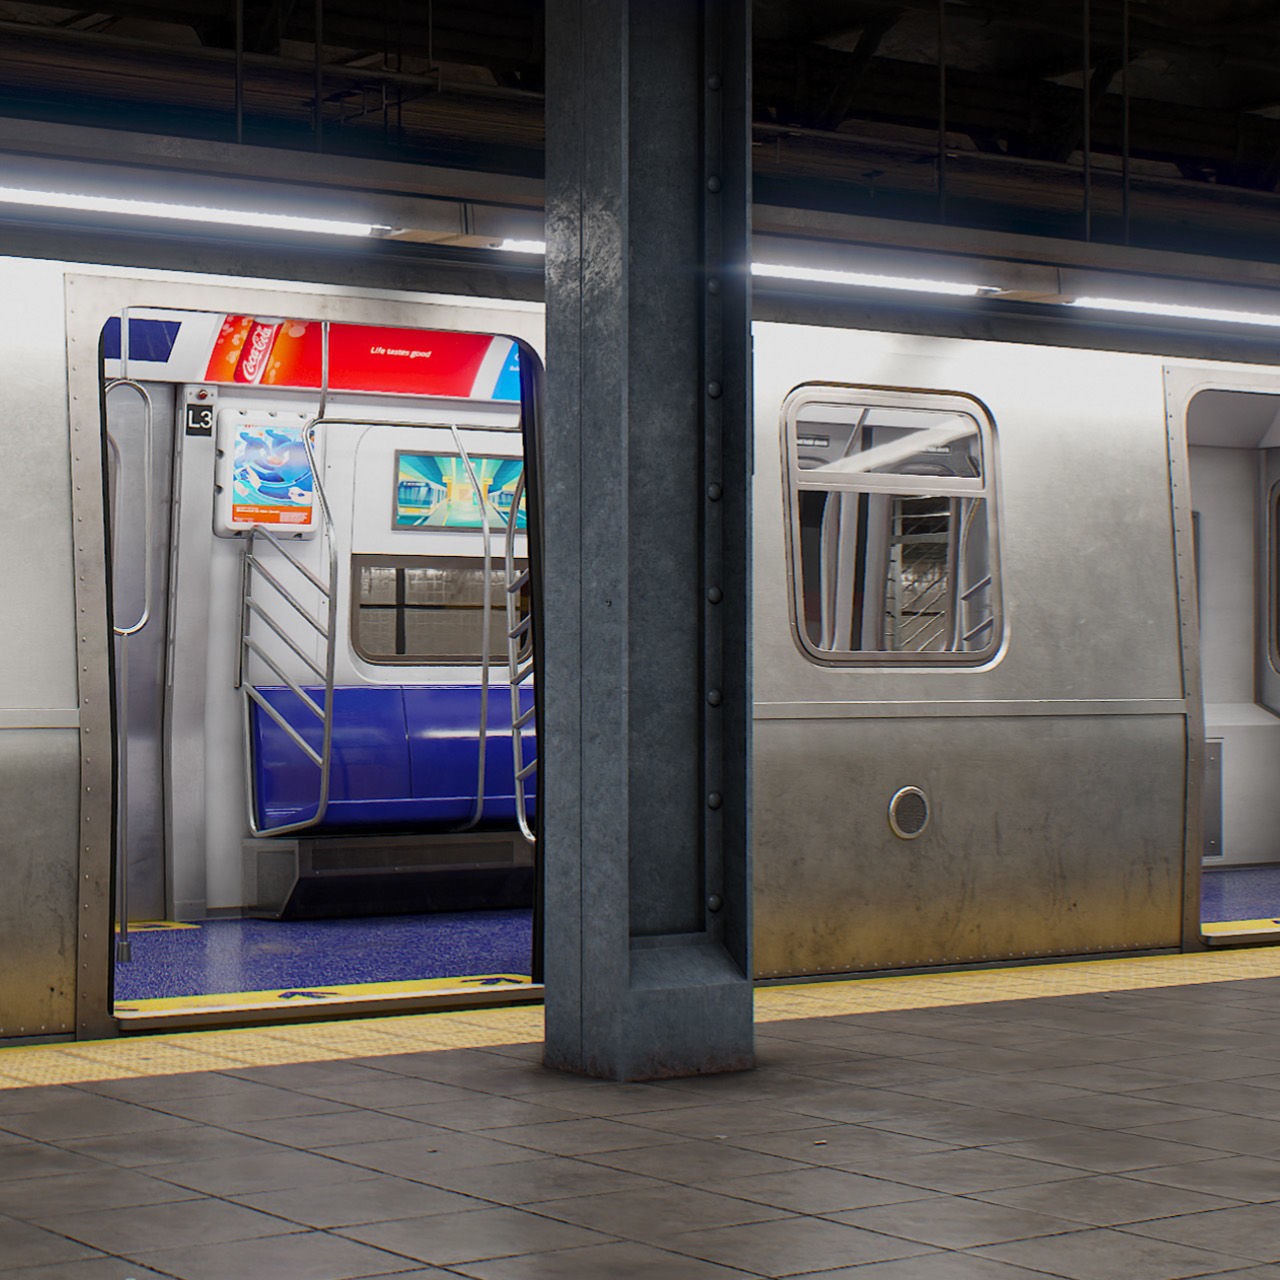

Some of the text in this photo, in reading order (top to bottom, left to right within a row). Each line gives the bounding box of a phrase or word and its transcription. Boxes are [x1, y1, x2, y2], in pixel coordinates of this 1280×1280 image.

[370, 346, 432, 360] Life tastes good
[187, 409, 213, 429] L3
